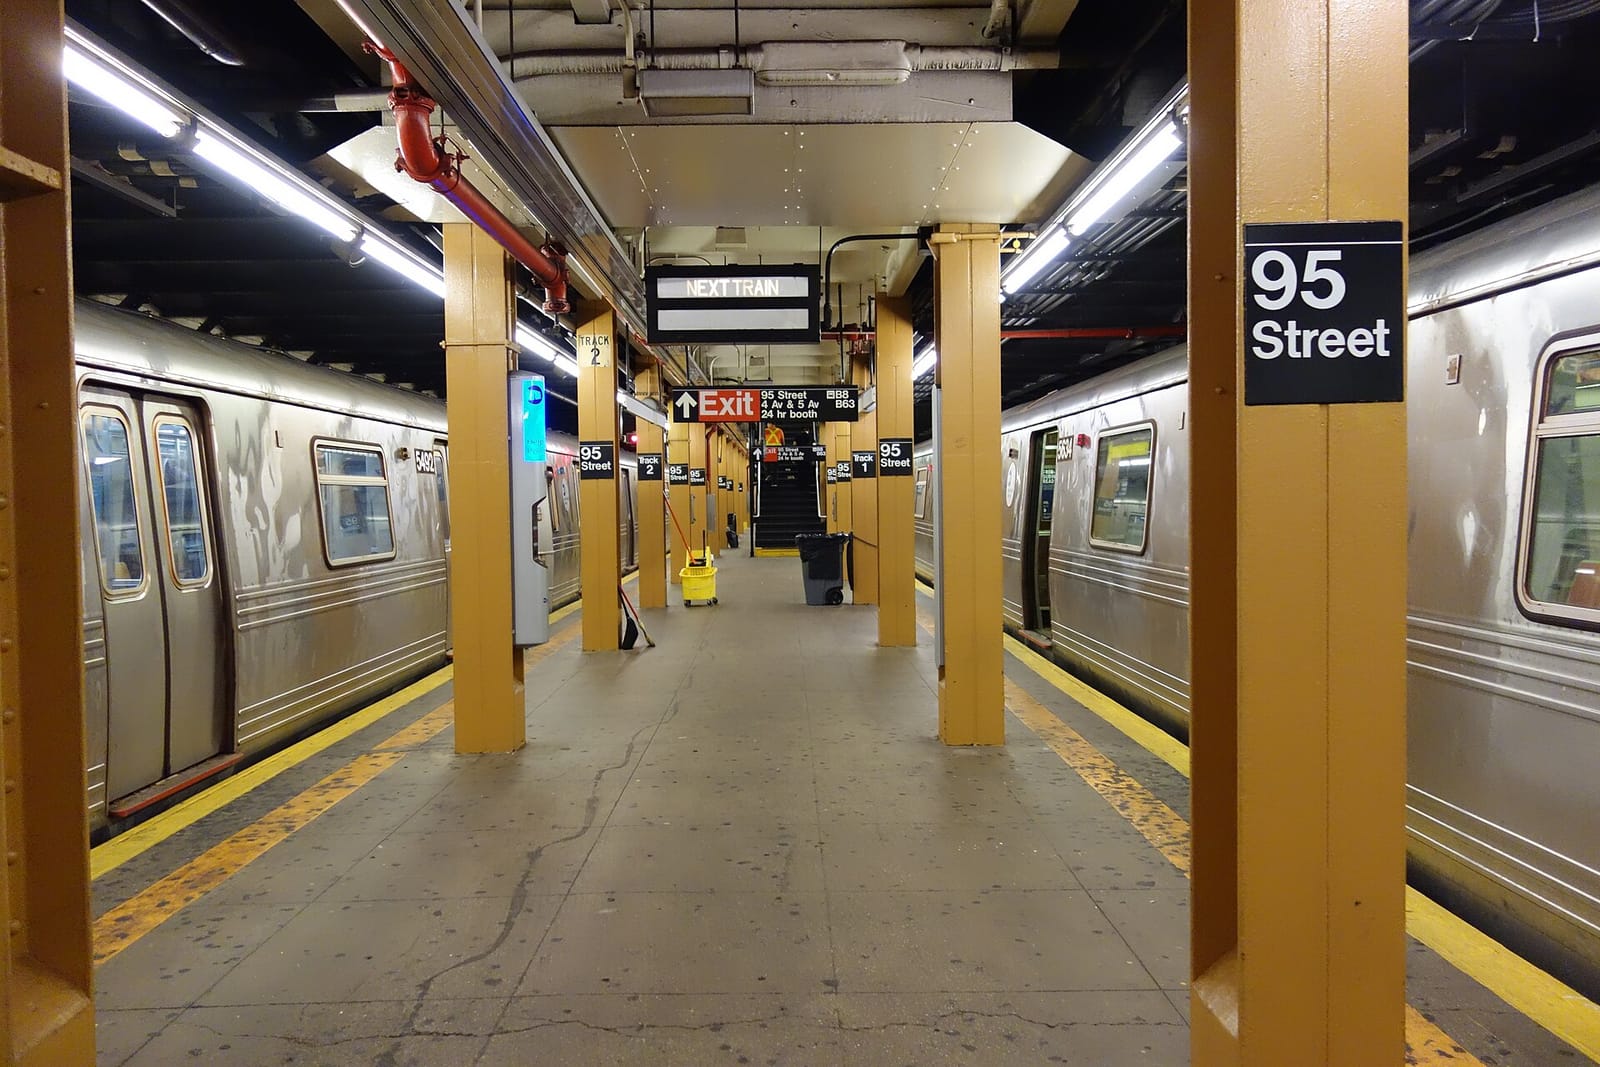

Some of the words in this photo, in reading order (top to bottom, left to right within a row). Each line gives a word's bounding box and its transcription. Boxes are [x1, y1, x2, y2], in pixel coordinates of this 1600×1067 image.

[1251, 249, 1346, 311] 95
[686, 279, 729, 297] NEXT
[731, 279, 779, 297] TRAIN
[580, 335, 609, 346] TRACK
[1252, 318, 1391, 360] Street
[590, 347, 600, 365] 2
[761, 390, 774, 399] 95
[777, 390, 807, 399] Street
[835, 390, 849, 399] B8
[700, 390, 754, 416] Exit
[761, 400, 768, 409] 4
[771, 400, 784, 409] Av
[786, 400, 794, 409] &
[797, 400, 804, 409] 5
[808, 400, 820, 409] Av
[835, 400, 855, 409] B63
[761, 410, 774, 418] 24
[777, 410, 787, 418] hr
[790, 410, 818, 418] booth
[580, 446, 602, 460] 95
[880, 443, 901, 457] 95
[415, 450, 435, 473] 5492
[638, 456, 659, 465] Track
[853, 454, 874, 462] Track
[880, 457, 911, 467] Street
[581, 460, 612, 471] Street
[646, 464, 654, 475] 2
[670, 466, 682, 475] 95
[837, 463, 850, 472] 95
[861, 462, 867, 473] 1
[690, 470, 700, 478] 95
